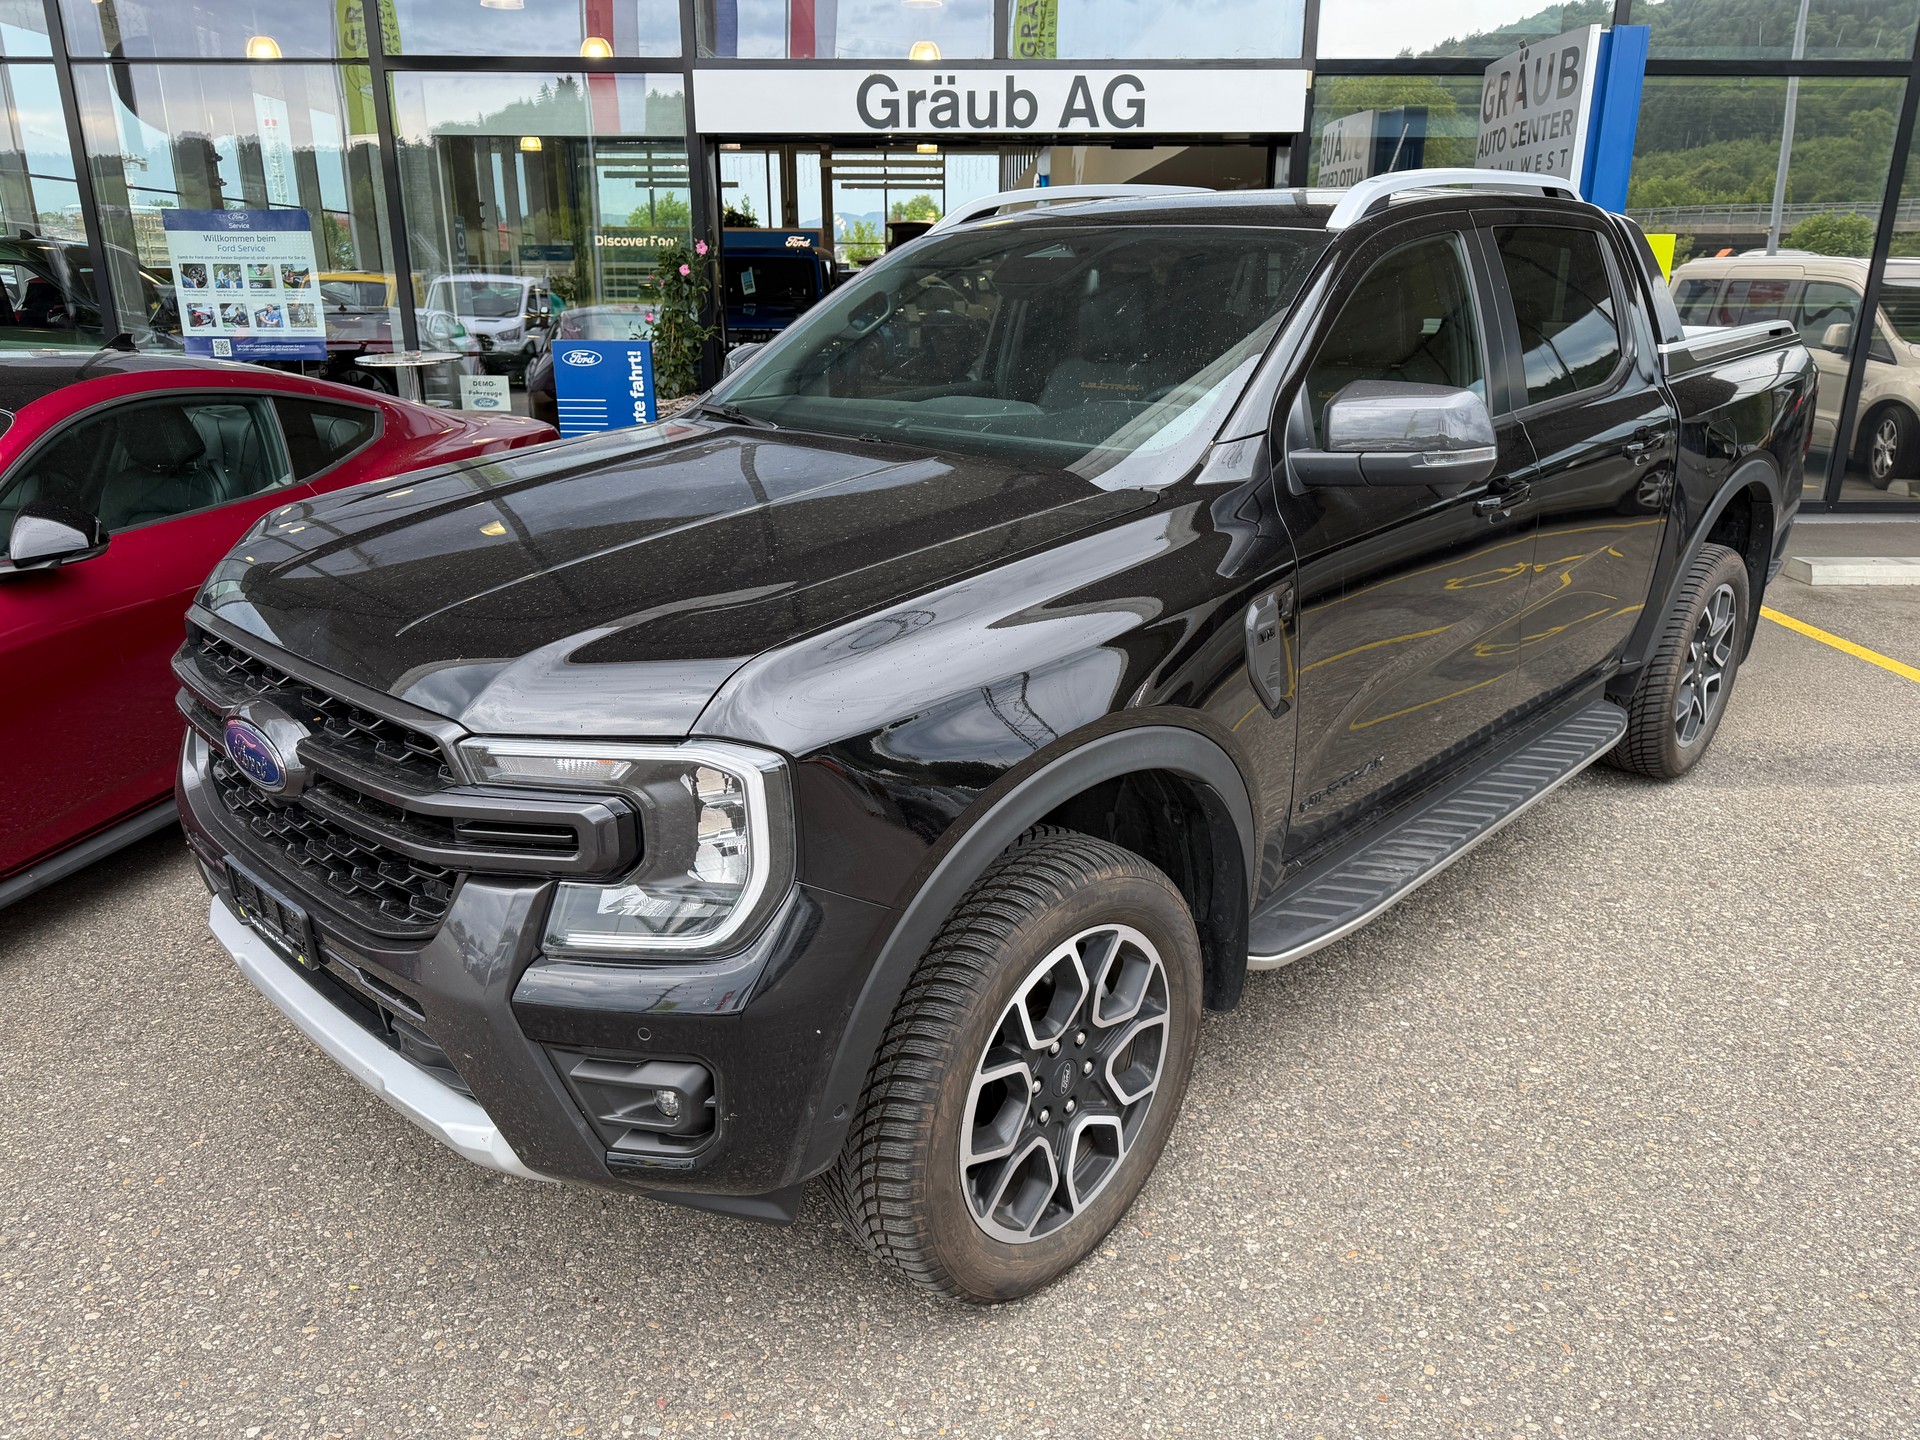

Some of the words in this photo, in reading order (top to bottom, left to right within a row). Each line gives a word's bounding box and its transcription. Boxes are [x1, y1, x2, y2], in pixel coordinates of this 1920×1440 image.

[1482, 45, 1580, 124] GRÄUB
[856, 73, 1039, 129] Gräub
[1057, 73, 1146, 129] AG
[1477, 126, 1507, 159] AUTO
[1510, 108, 1574, 149] CENTER
[1520, 148, 1569, 173] WEST
[203, 234, 255, 243] Willkommen
[256, 234, 277, 242] beim
[217, 244, 236, 252] Ford
[237, 244, 266, 252] Service
[594, 235, 648, 248] Discover
[784, 235, 812, 248] Ford
[567, 350, 597, 365] Ford
[626, 350, 645, 399] fahrt!
[232, 732, 268, 780] Ford
